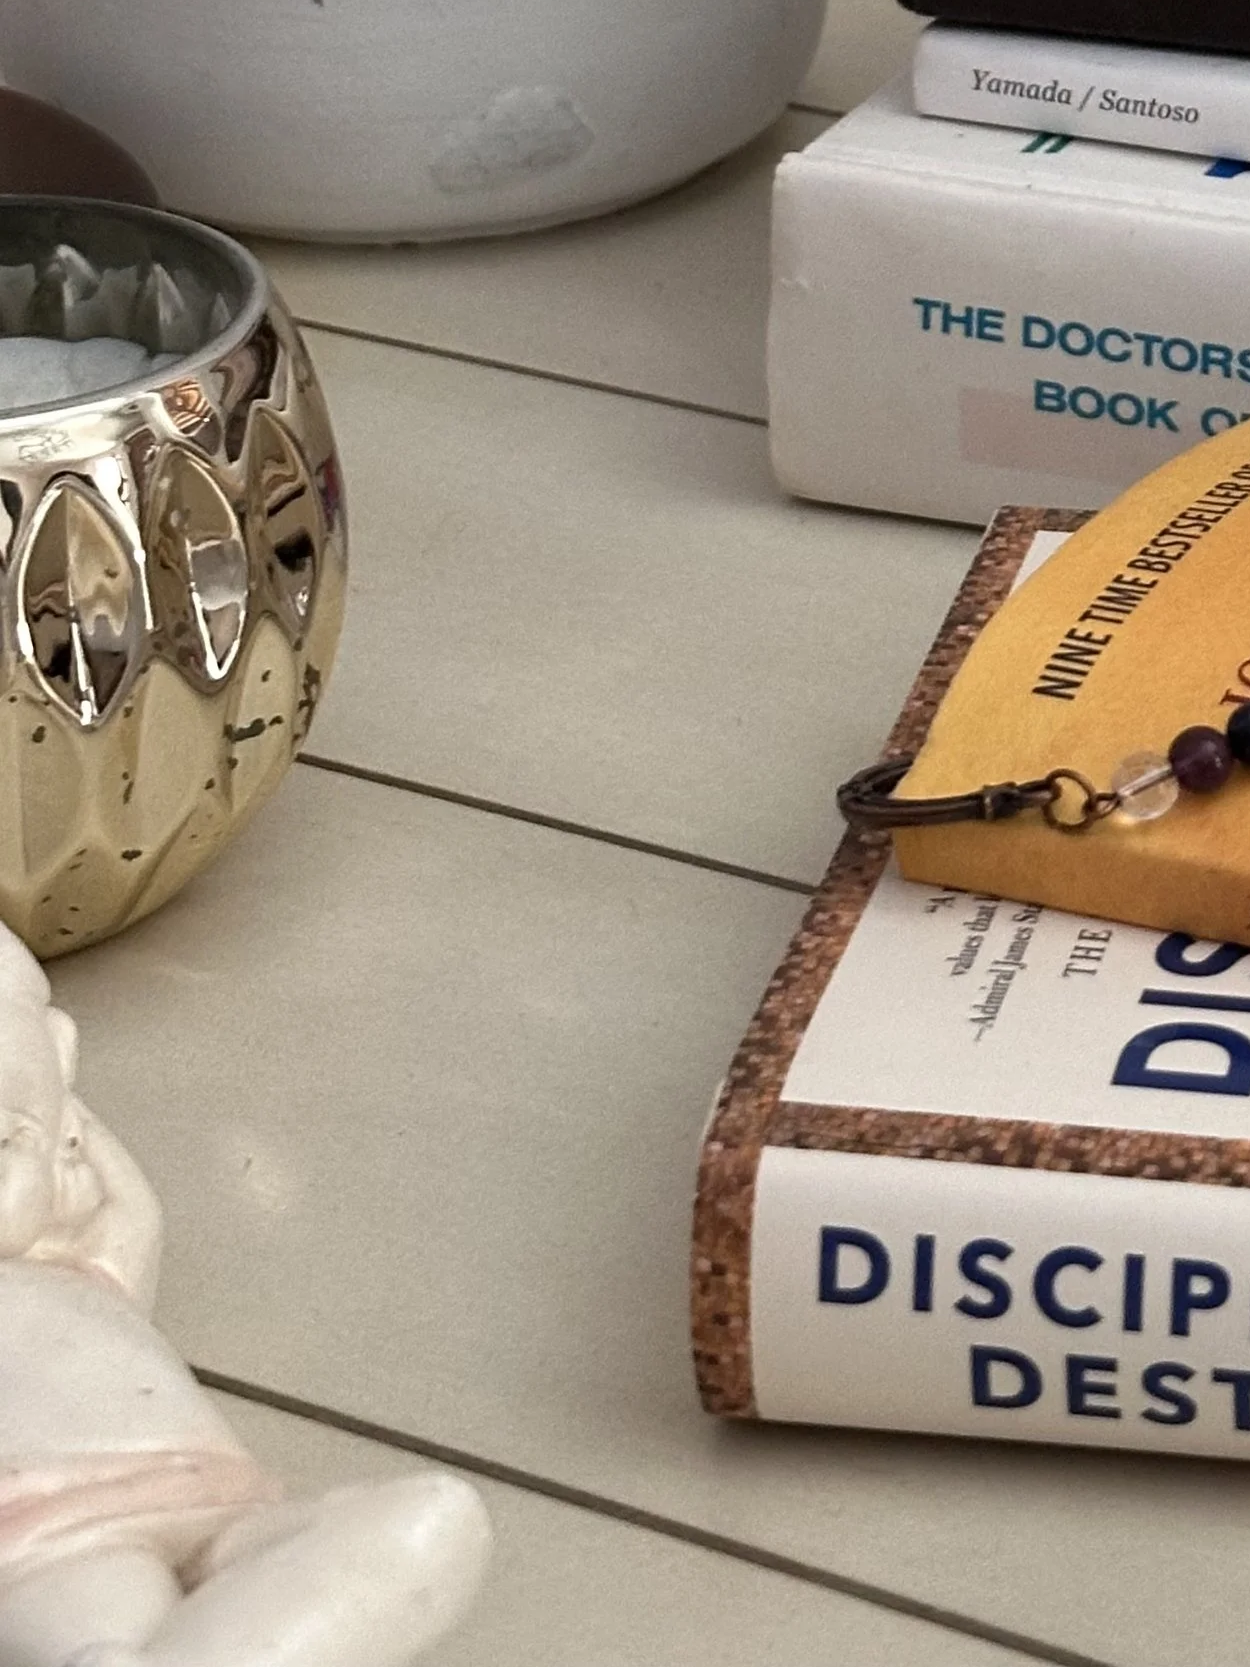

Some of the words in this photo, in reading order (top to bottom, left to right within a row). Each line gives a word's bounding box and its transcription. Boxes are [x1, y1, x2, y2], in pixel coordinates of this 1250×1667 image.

[972, 69, 1073, 107] Yamada
[1078, 86, 1096, 110] /
[1099, 88, 1200, 124] Santoso
[913, 298, 1006, 343] THE
[1032, 379, 1178, 431] BOOK
[1032, 628, 1112, 700] NINE
[1078, 574, 1160, 624] TIME
[946, 935, 985, 976] values
[991, 926, 1034, 970] James
[1062, 928, 1113, 977] THE
